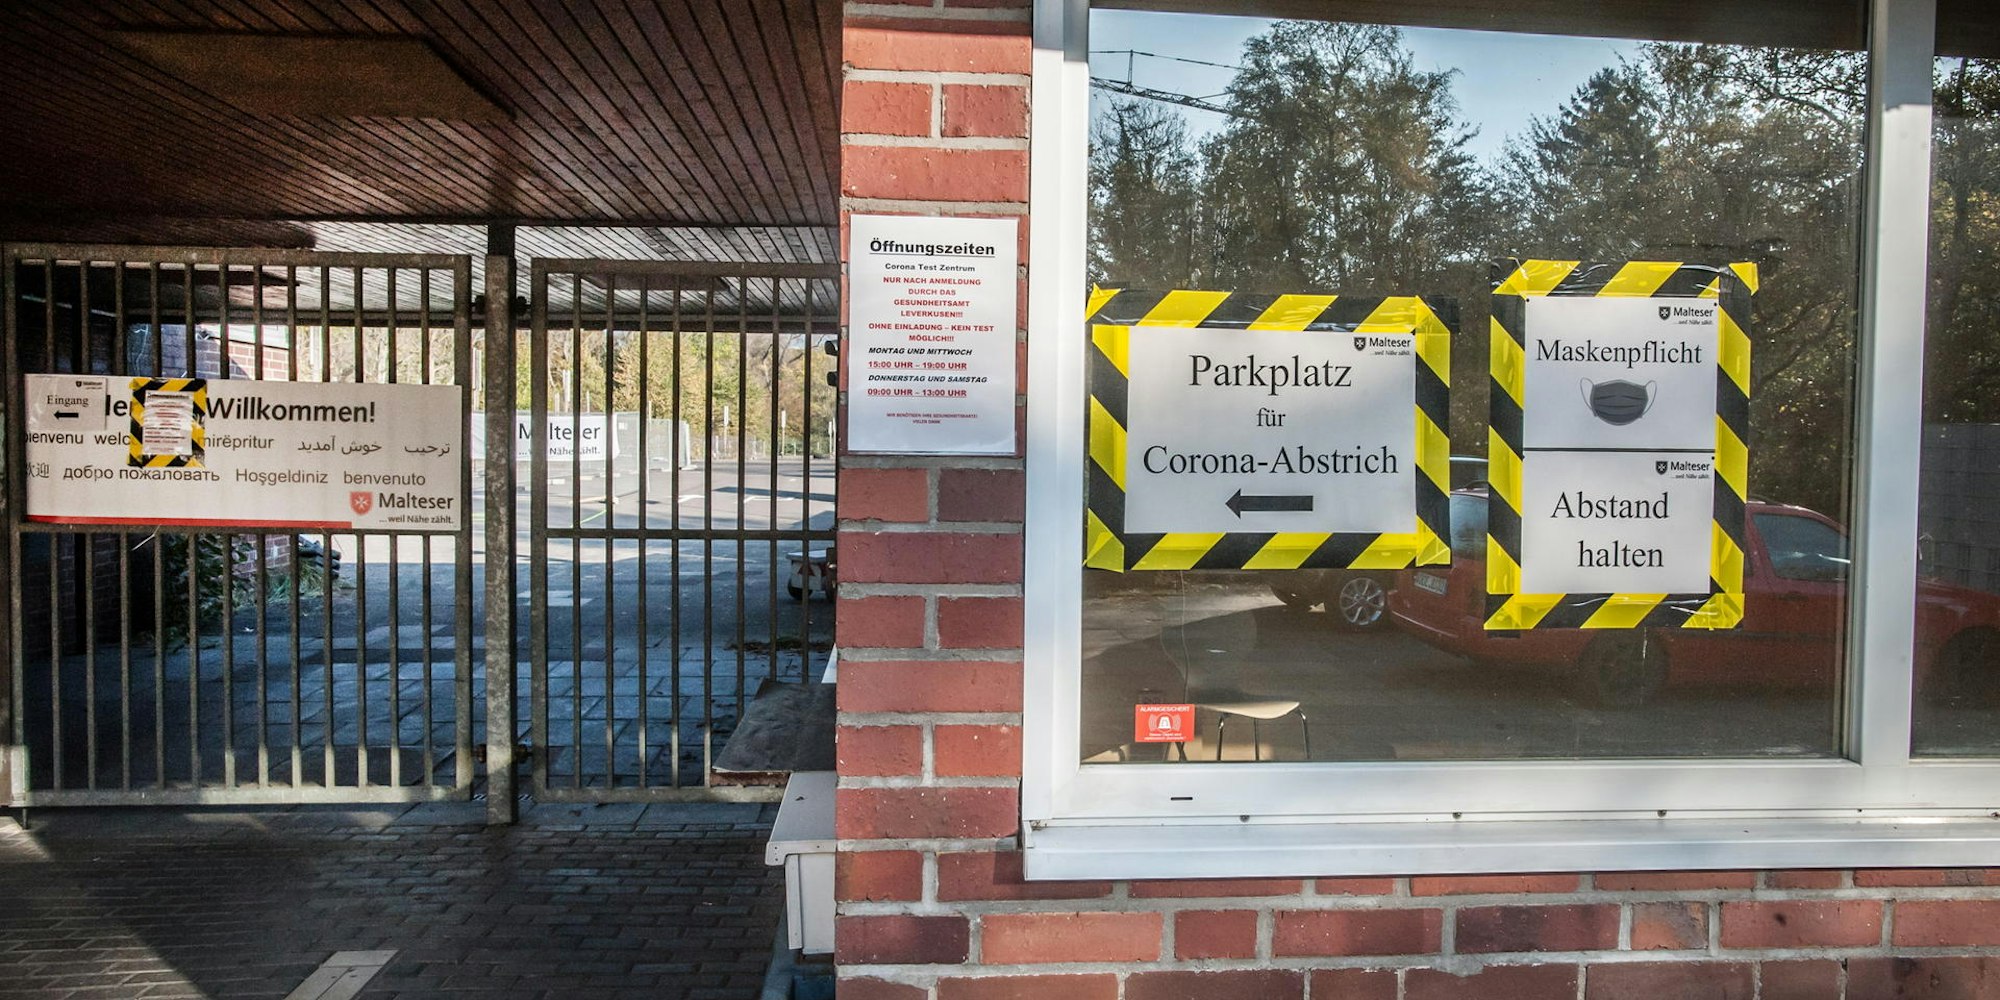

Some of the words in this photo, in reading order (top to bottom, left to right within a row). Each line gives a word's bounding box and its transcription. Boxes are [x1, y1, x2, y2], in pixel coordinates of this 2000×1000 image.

[869, 237, 995, 256] Öffnungszeiten
[885, 263, 916, 271] Corona
[918, 263, 937, 271] Test
[939, 264, 976, 272] Zentrum
[929, 278, 982, 286] ANMELDUNG
[893, 299, 971, 307] GESUNDHEITSAMT
[900, 310, 964, 318] LEVERKUSEN!!!
[1673, 307, 1714, 317] Malteser
[868, 322, 893, 330] OHNE
[894, 323, 943, 332] EINLADUNG
[951, 324, 972, 332] KEIN
[974, 324, 995, 333] TEST
[908, 334, 955, 342] MÖGLICH!!!
[1369, 337, 1411, 348] Malteser
[868, 347, 906, 355] MONTAG
[907, 347, 926, 355] UND
[926, 348, 973, 356] MITTWOCH
[1536, 339, 1703, 370] Maskenpflicht
[868, 361, 892, 369] 15:00
[893, 361, 913, 369] UHR
[922, 361, 946, 369] 19:00
[947, 362, 968, 370] UHR
[868, 374, 926, 382] DONNERSTAG
[928, 375, 946, 383] UND
[947, 376, 988, 384] SAMSTAG
[1188, 354, 1353, 397] Parkplatz
[867, 388, 892, 396] 09:00
[893, 388, 913, 396] UHR
[922, 389, 946, 397] 13:00
[947, 389, 968, 397] UHR
[46, 394, 89, 407] Eingang
[206, 396, 376, 424] Willkommen!
[1256, 407, 1286, 428] für
[519, 422, 601, 440] Mlteer
[1142, 445, 1399, 476] Corona-Abstrich
[1670, 461, 1711, 471] Malteser
[63, 465, 114, 482] добро
[119, 467, 220, 482] пожаловать
[235, 468, 329, 486] Hoşgeldiniz
[343, 470, 426, 486] benvenuto
[378, 492, 455, 510] Malteser
[1549, 491, 1670, 519] Abstand
[406, 514, 430, 524] Nähe
[1577, 540, 1664, 568] halten
